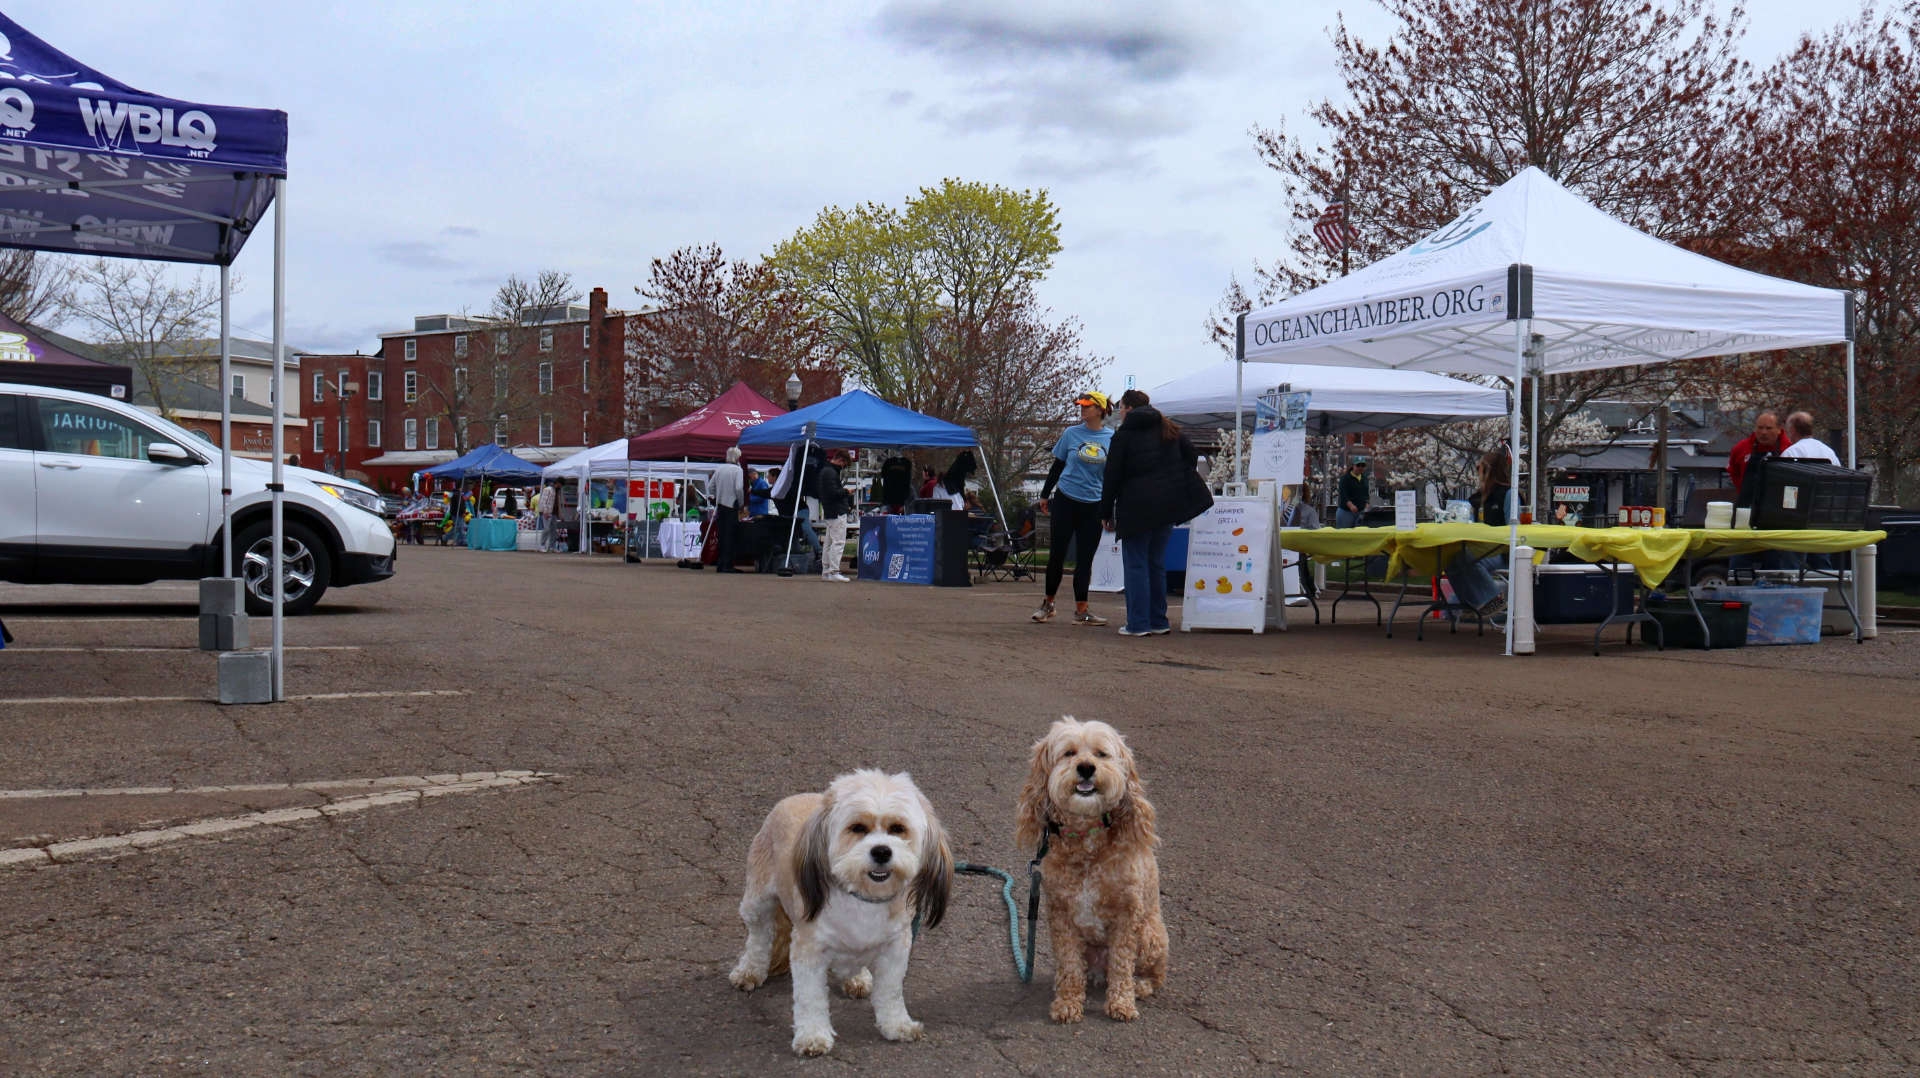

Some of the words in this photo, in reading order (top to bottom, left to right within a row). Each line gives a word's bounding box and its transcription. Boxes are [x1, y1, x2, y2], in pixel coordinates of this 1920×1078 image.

[3, 129, 28, 138] .NET
[78, 97, 217, 153] WBLQ
[187, 149, 210, 159] .NET
[1254, 284, 1485, 347] OCEANCHAMBER.ORG
